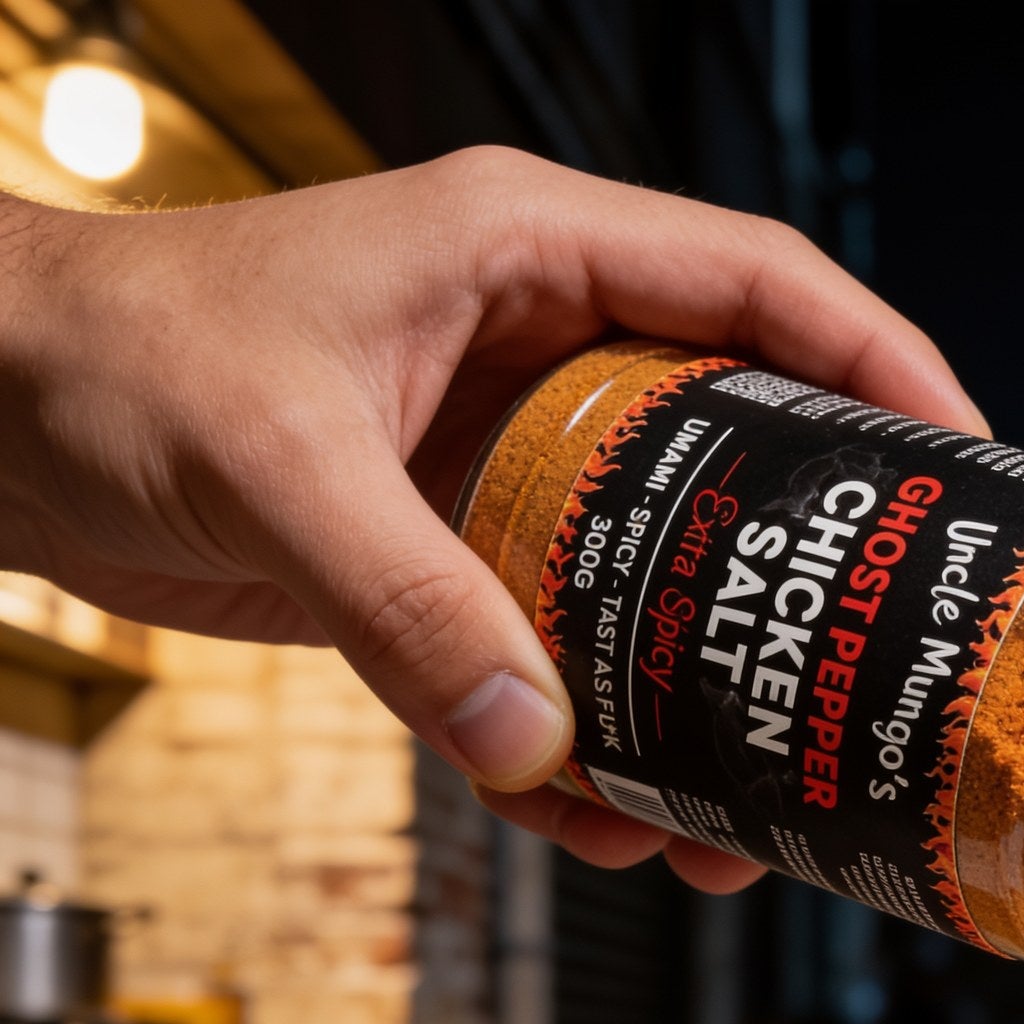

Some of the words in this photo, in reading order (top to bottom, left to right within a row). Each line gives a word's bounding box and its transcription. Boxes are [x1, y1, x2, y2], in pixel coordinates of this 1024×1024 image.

[645, 418, 711, 491] UMAMI
[574, 515, 612, 589] 300G
[612, 507, 651, 577] SPICY
[671, 489, 738, 578] Extra
[839, 476, 943, 624] GHOST
[931, 520, 998, 626] Uncle
[595, 596, 622, 657] TAST
[639, 587, 696, 693] Spicy
[700, 521, 788, 684] SALT
[745, 480, 877, 756] CHICKEN
[594, 657, 613, 694] AS
[804, 626, 866, 810] PEPPER
[868, 636, 960, 801] Mungo's
